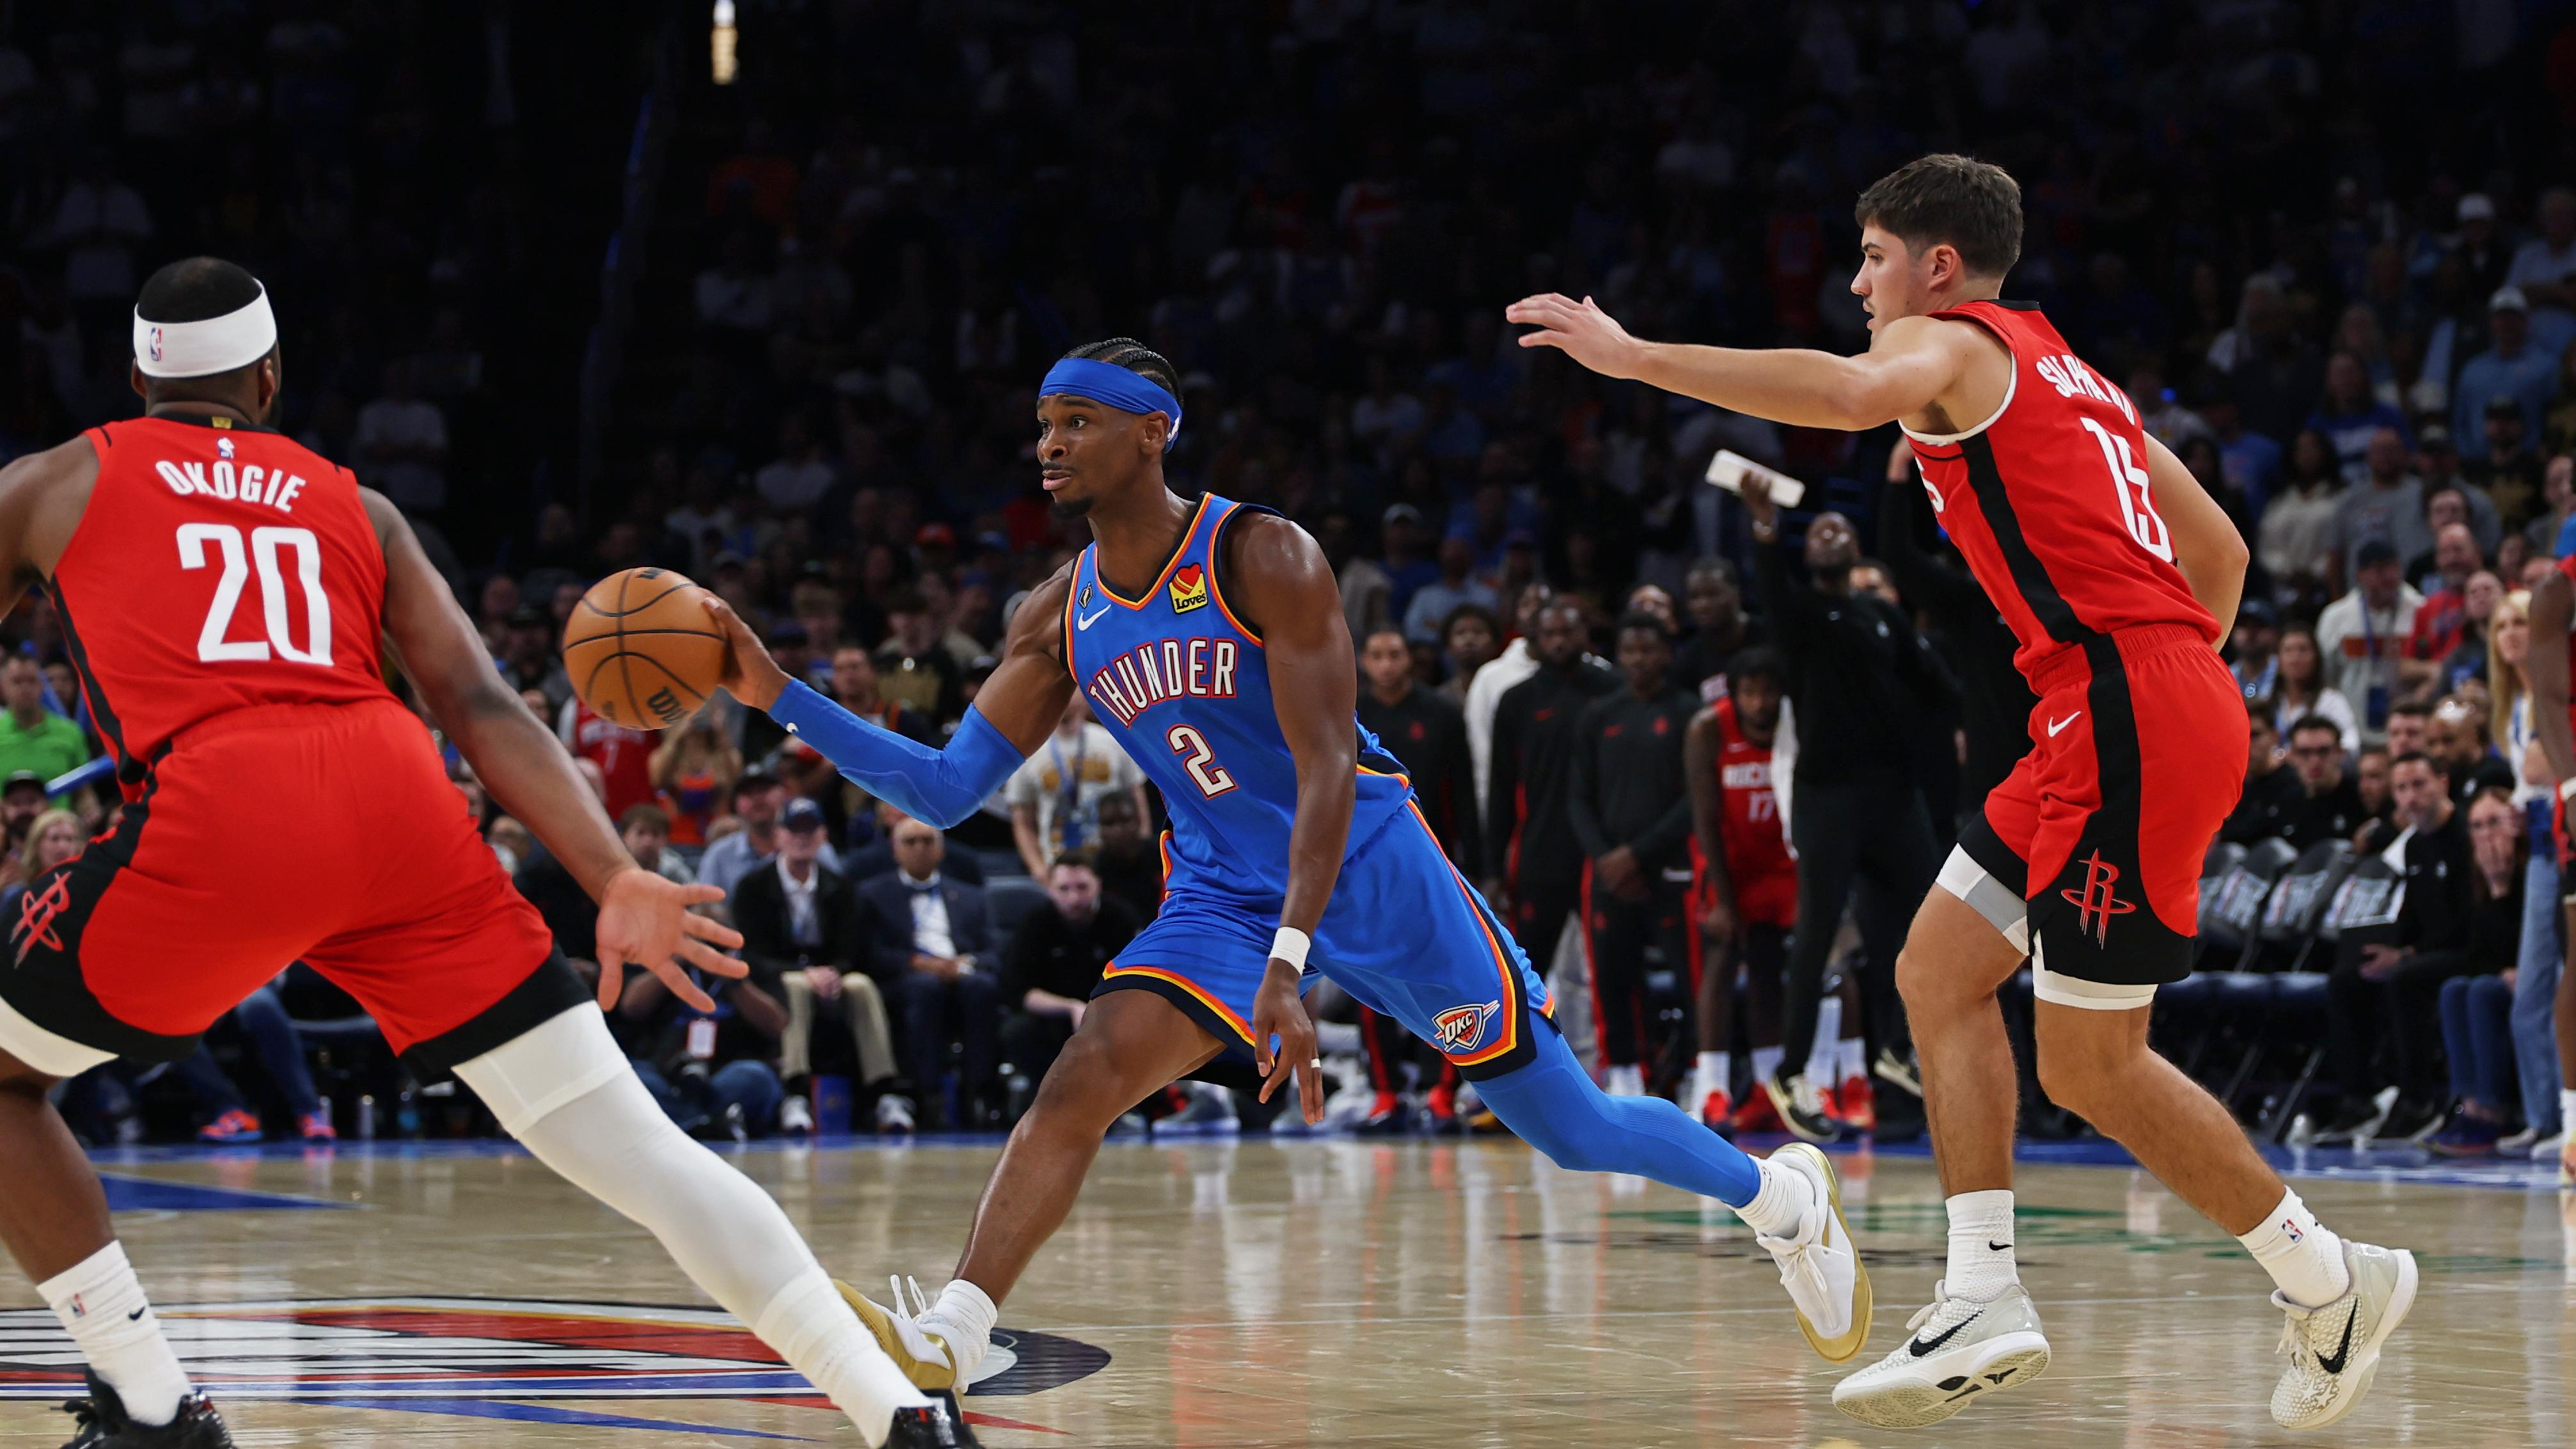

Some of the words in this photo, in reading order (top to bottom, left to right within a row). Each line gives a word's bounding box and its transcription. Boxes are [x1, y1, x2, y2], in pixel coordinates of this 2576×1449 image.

[155, 461, 306, 512] OKOGIE
[2080, 417, 2172, 563] 15
[176, 523, 335, 667] 20
[1087, 637, 1239, 729] THUNDER
[1166, 724, 1239, 800] 2
[1444, 1012, 1473, 1045] OKC
